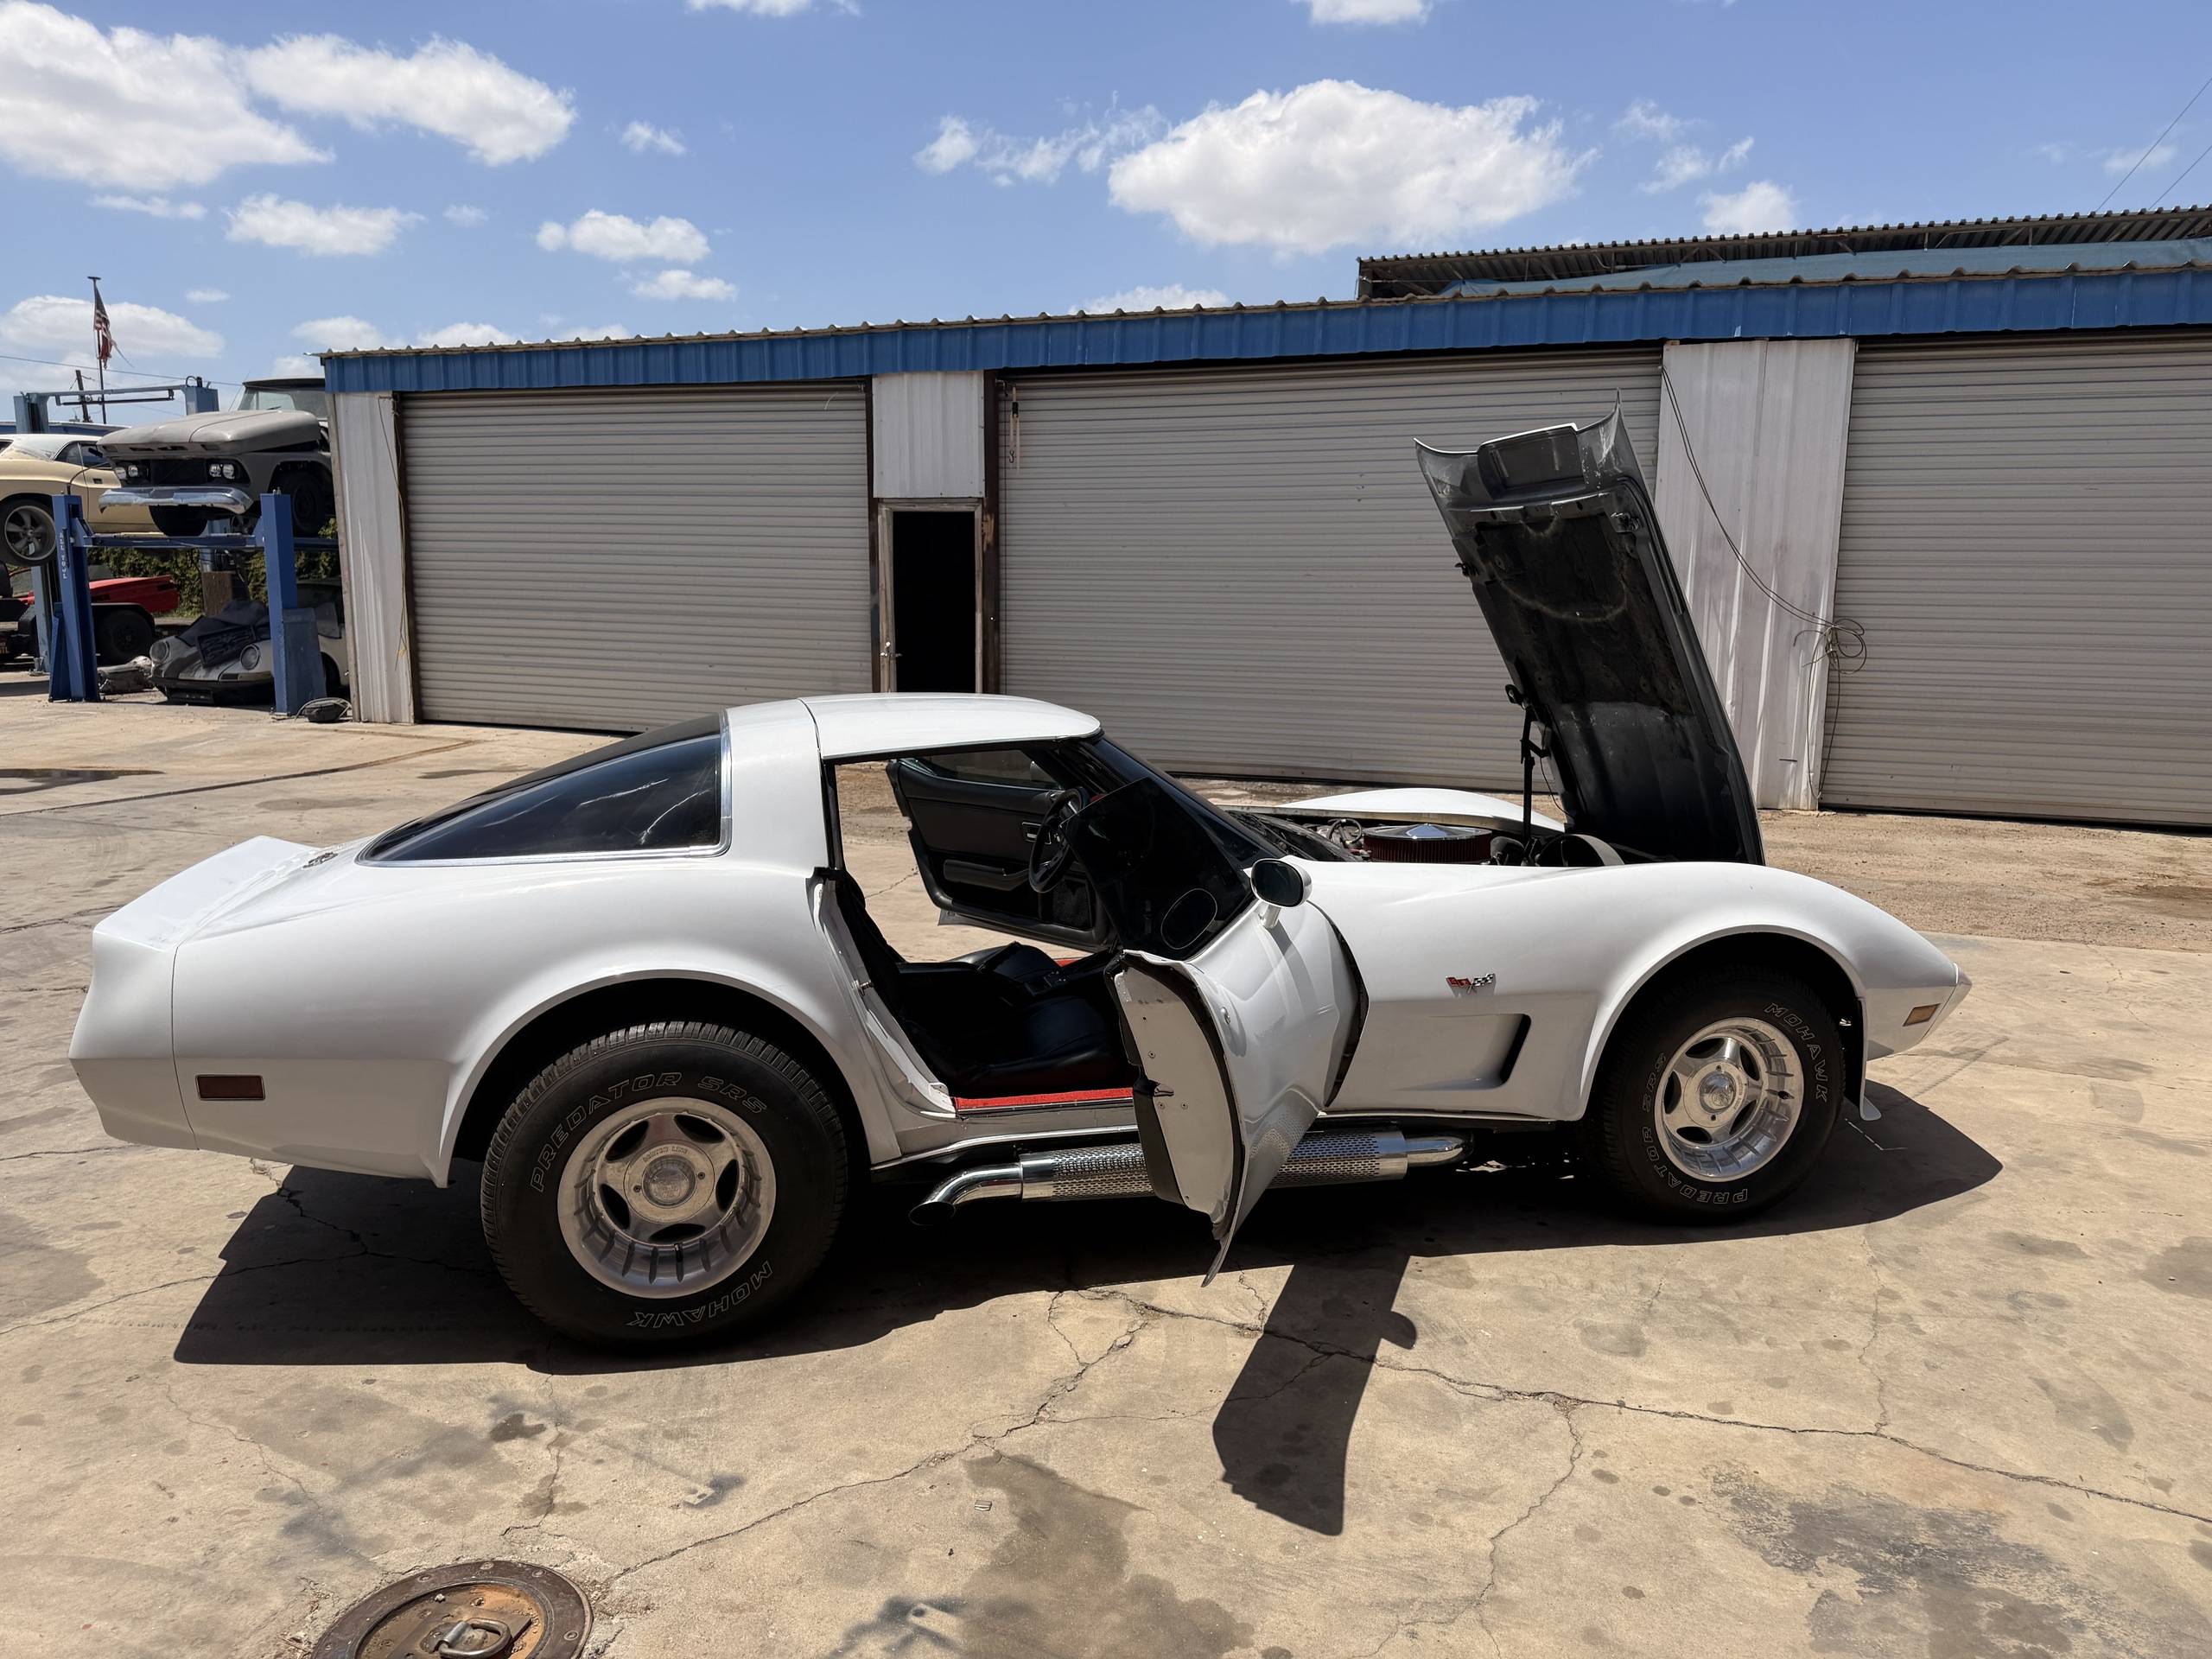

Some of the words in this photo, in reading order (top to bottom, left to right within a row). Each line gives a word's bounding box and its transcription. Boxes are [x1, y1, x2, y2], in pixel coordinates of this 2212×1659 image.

[1764, 1002, 1828, 1103] MOHAWK
[531, 1071, 682, 1192] PREDATOR
[697, 1076, 768, 1114] SRS
[1642, 1126, 1749, 1205] PREDATOR
[626, 1260, 773, 1329] MOHAWK
